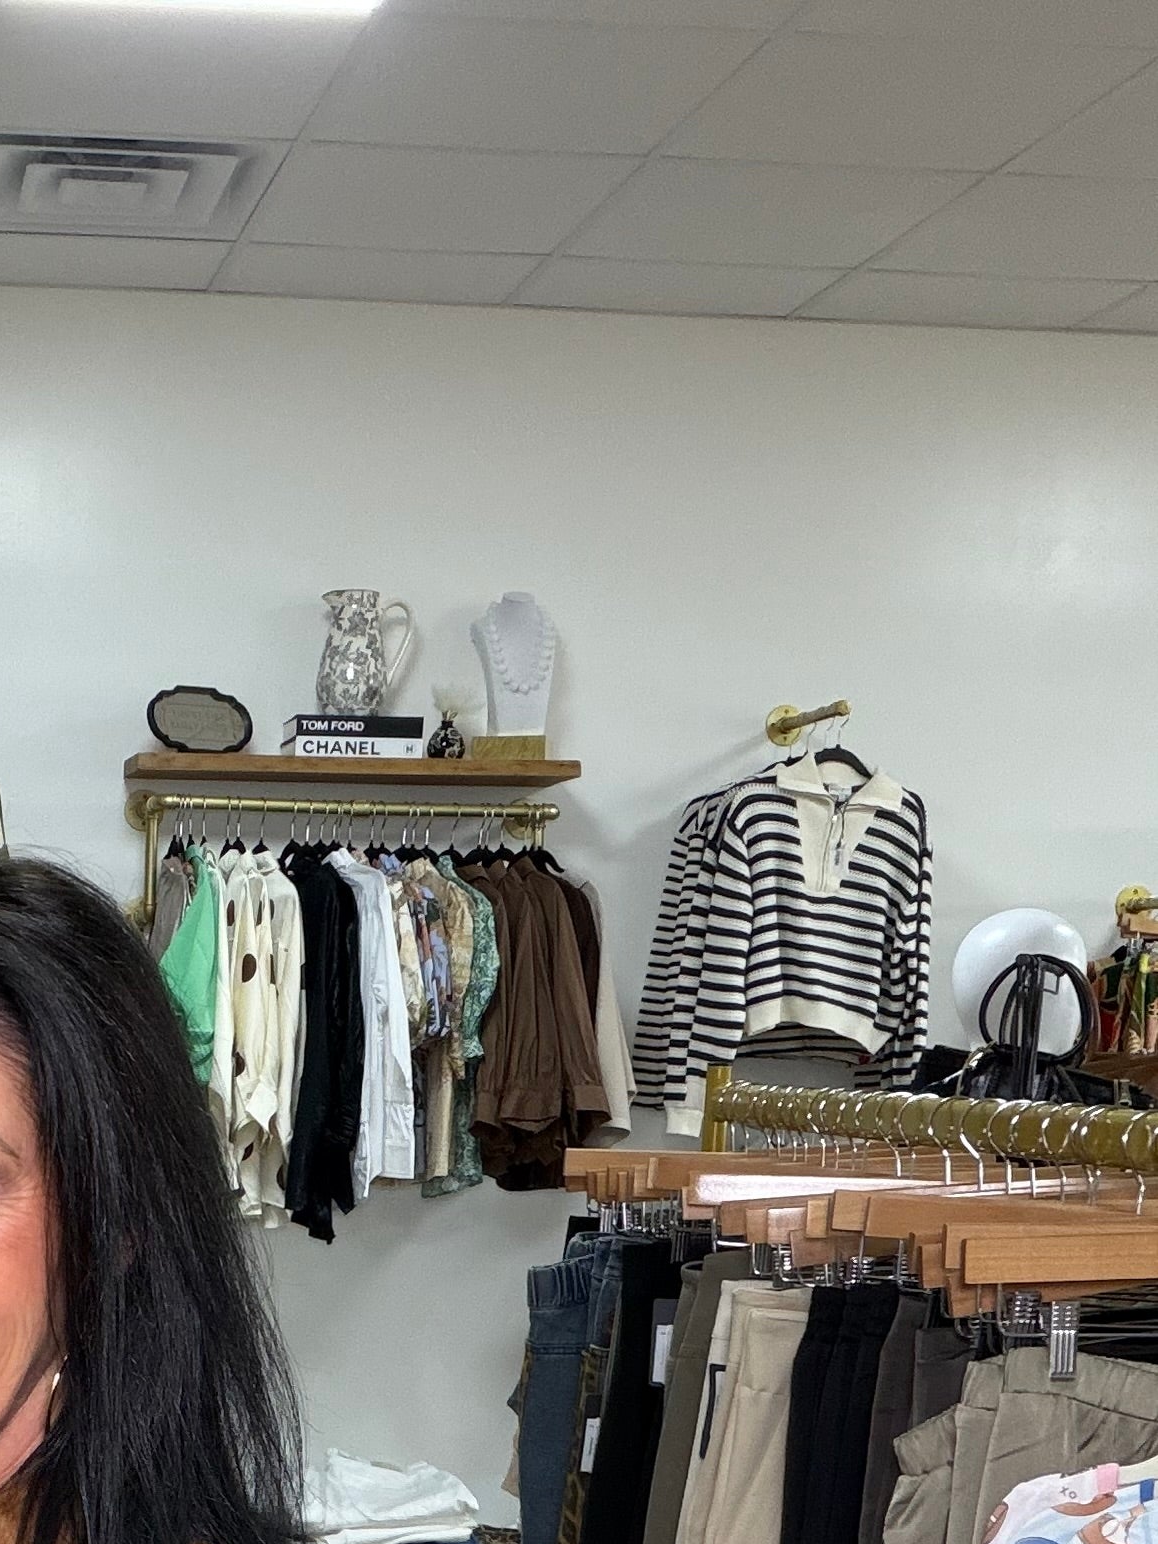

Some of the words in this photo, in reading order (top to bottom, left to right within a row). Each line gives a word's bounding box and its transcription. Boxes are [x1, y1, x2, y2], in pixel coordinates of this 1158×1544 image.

[301, 720, 329, 731] TOM
[331, 720, 365, 732] FORD
[302, 739, 380, 756] CHANEL
